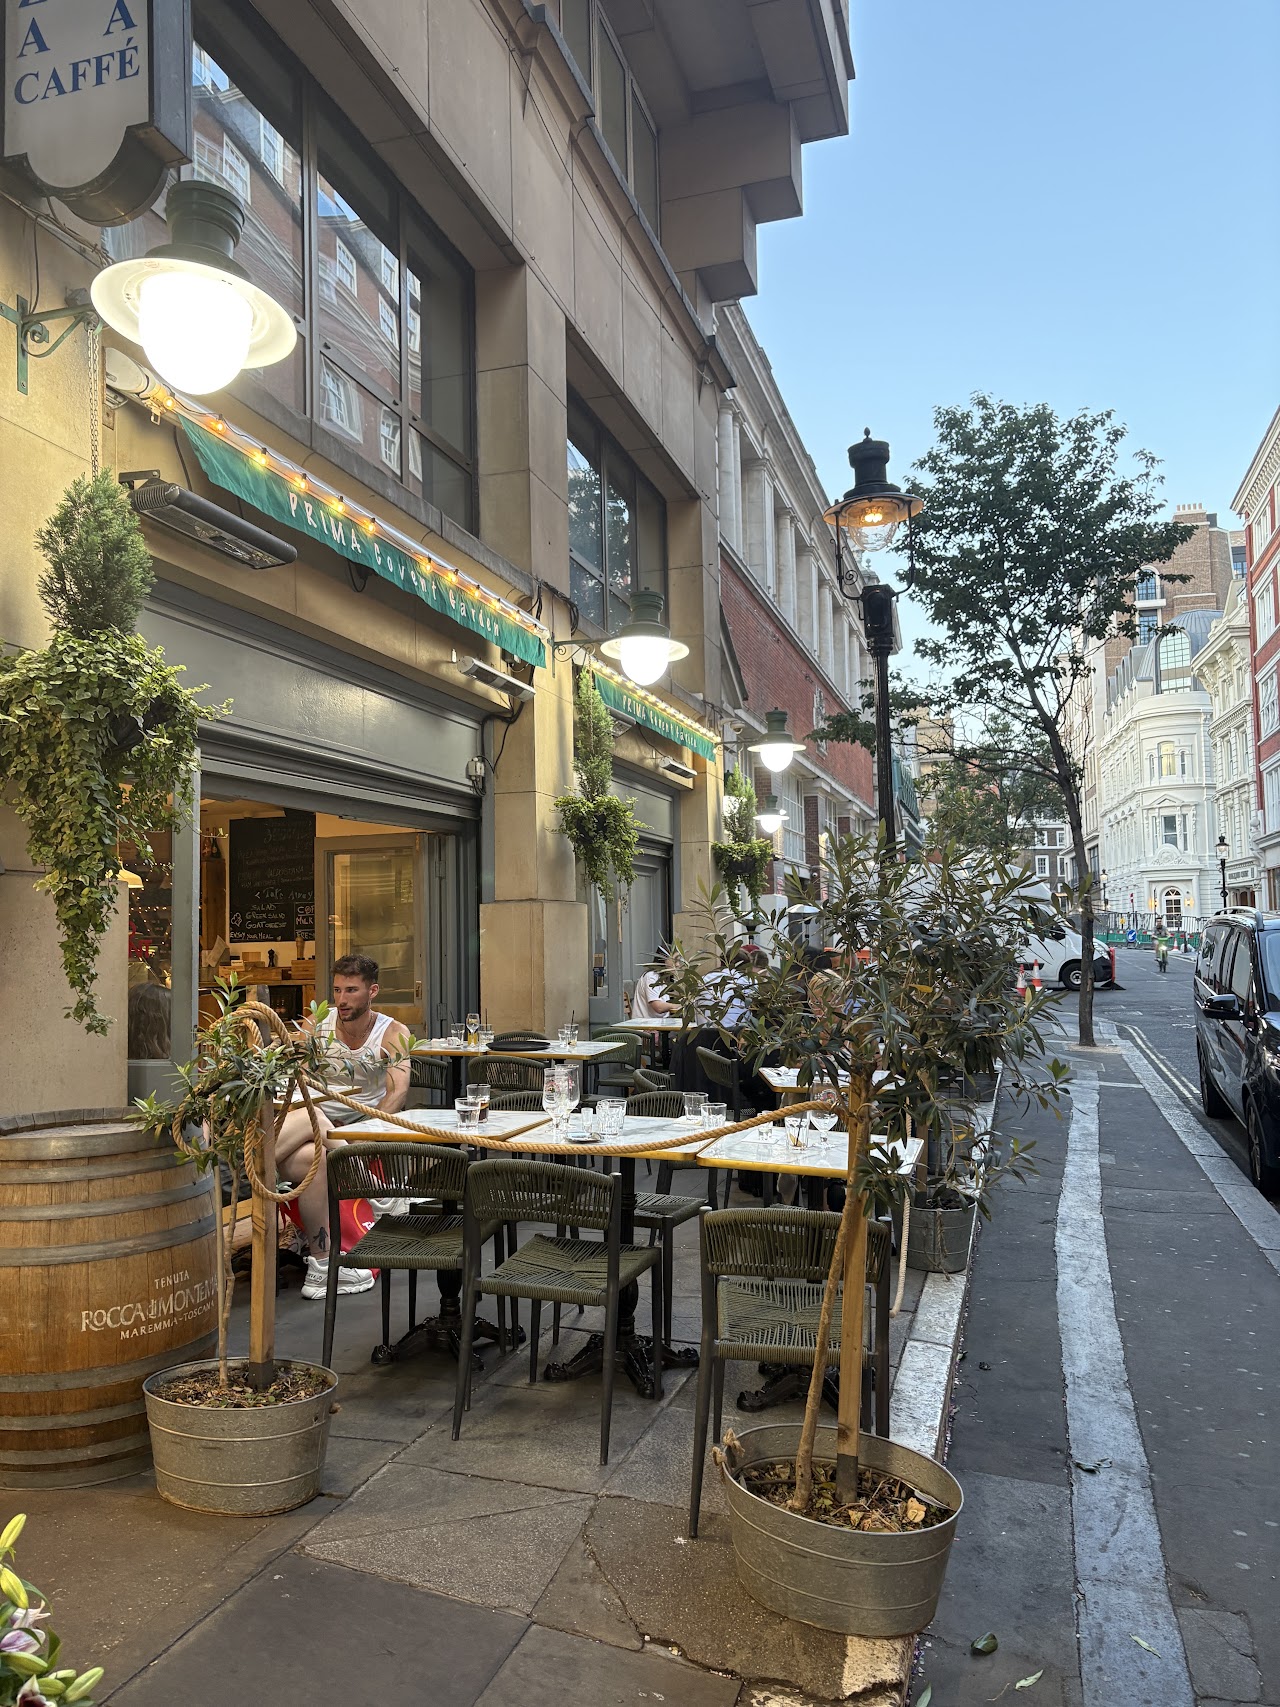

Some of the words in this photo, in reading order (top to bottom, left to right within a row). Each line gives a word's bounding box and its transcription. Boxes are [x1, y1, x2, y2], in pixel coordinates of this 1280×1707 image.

[17, 0, 51, 58] A
[14, 37, 140, 105] CAFFÉ
[289, 492, 362, 554] PRIMA
[374, 543, 437, 600] Covent
[449, 589, 500, 637] Garden
[623, 695, 646, 720] PRIMA
[154, 1270, 190, 1290] TENUTA
[81, 1303, 146, 1332] ROCCA
